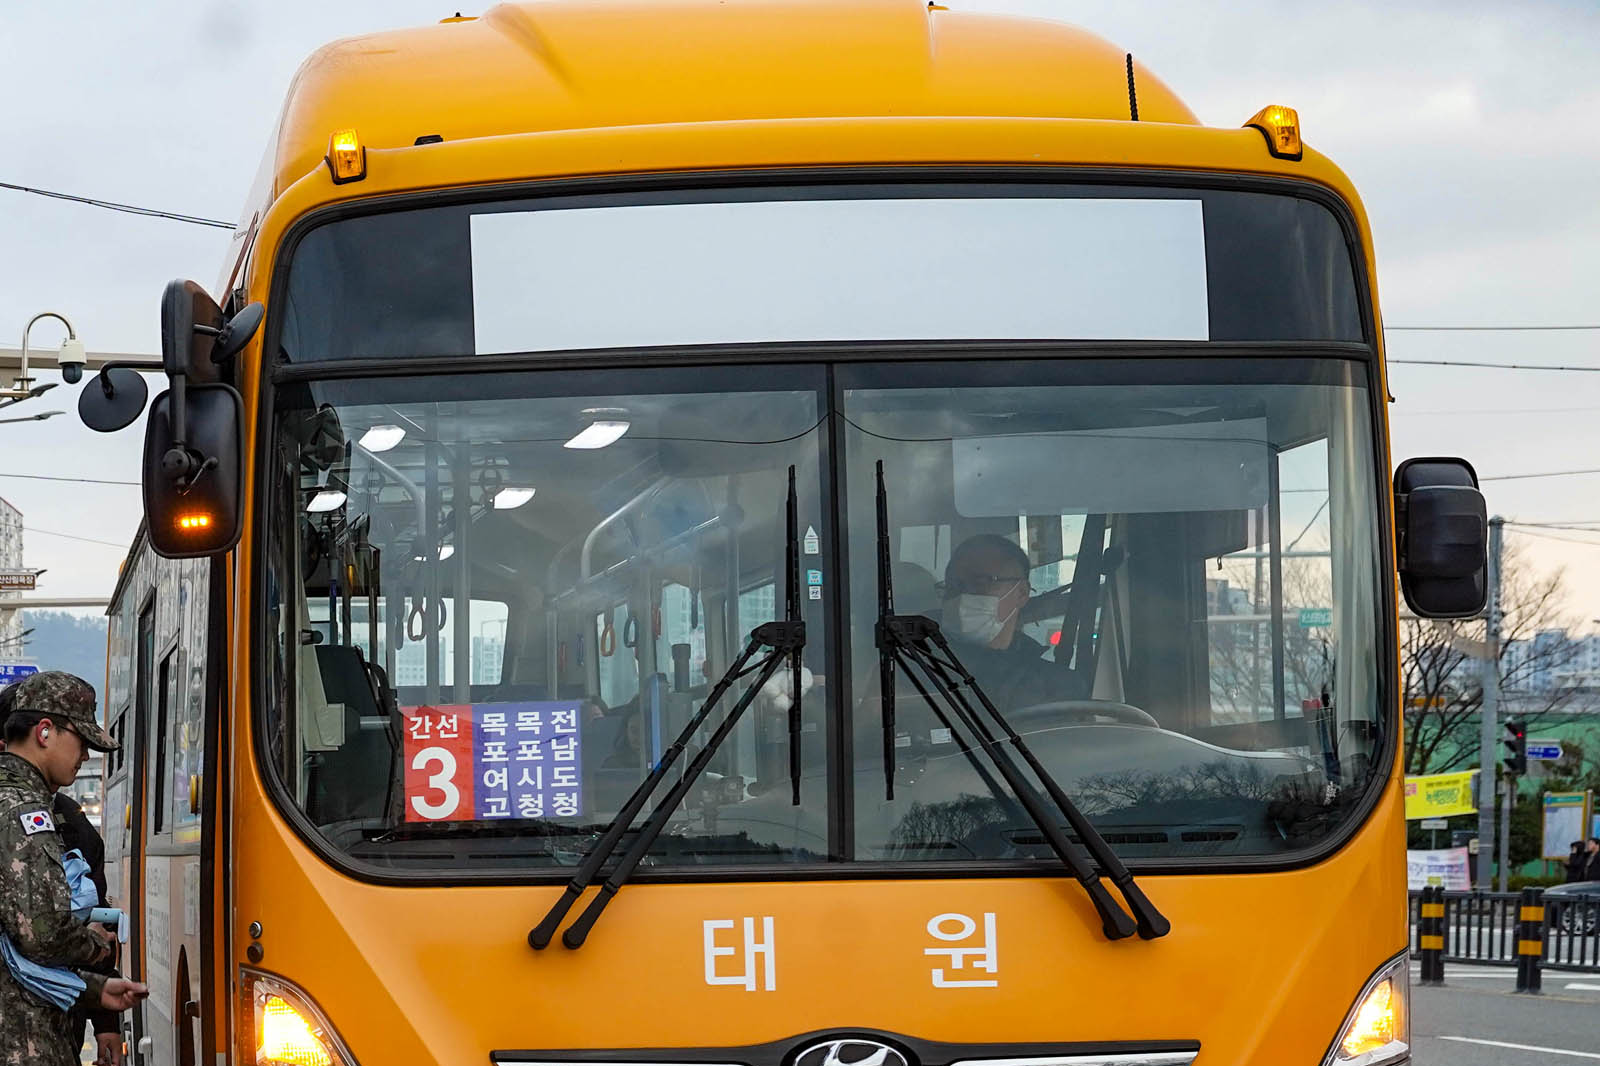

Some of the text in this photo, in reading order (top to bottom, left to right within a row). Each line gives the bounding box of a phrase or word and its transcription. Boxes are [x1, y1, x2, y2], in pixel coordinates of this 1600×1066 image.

[409, 714, 460, 740] 간선
[480, 712, 511, 818] 목포여고
[515, 711, 545, 818] 목포시청
[550, 709, 579, 817] 전남도청
[410, 746, 461, 820] 3
